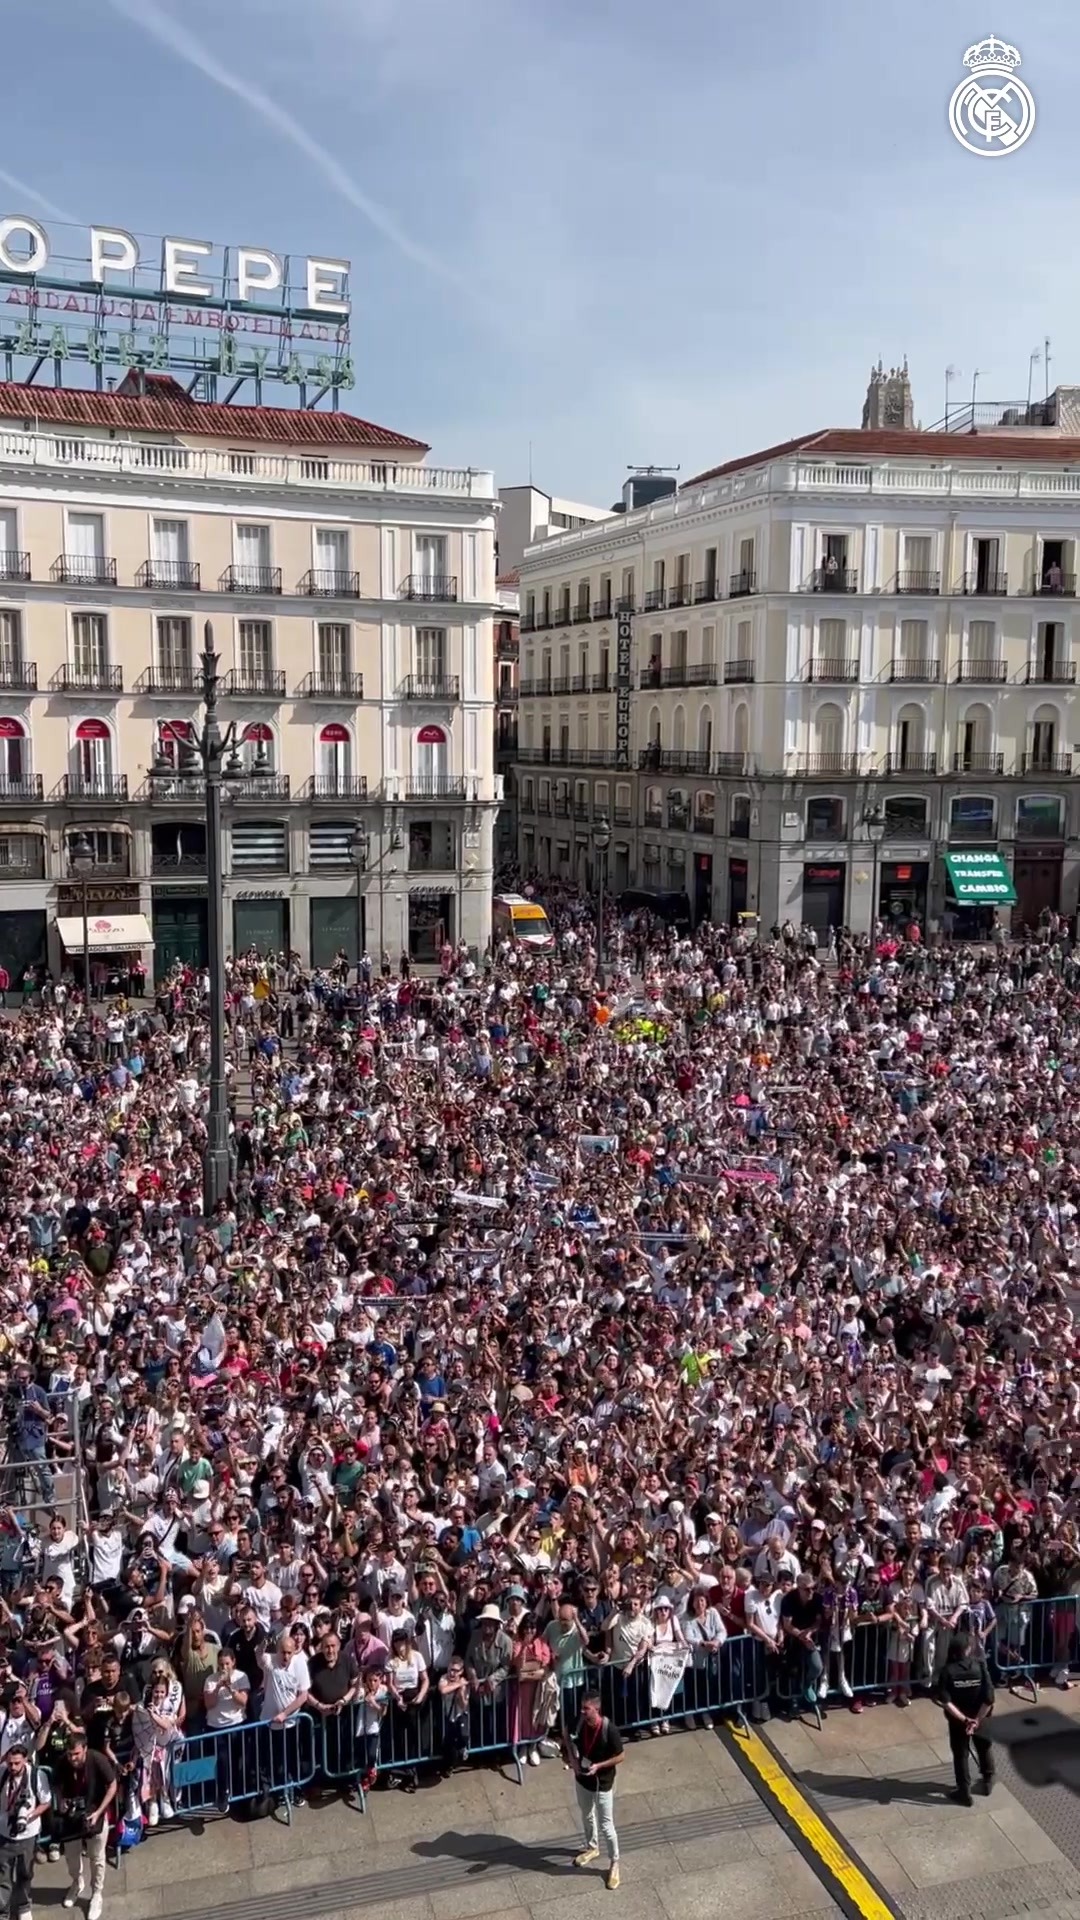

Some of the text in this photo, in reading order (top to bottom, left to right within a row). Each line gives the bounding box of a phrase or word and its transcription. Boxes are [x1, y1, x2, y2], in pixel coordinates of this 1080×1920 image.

[90, 224, 351, 314] PEPE
[618, 611, 631, 764] HOTEL EUROPA
[950, 854, 1000, 863] CHANGE
[954, 870, 1005, 878] TRANSFER
[959, 884, 1009, 893] CAMBIO
[75, 946, 107, 954] HEADOS
